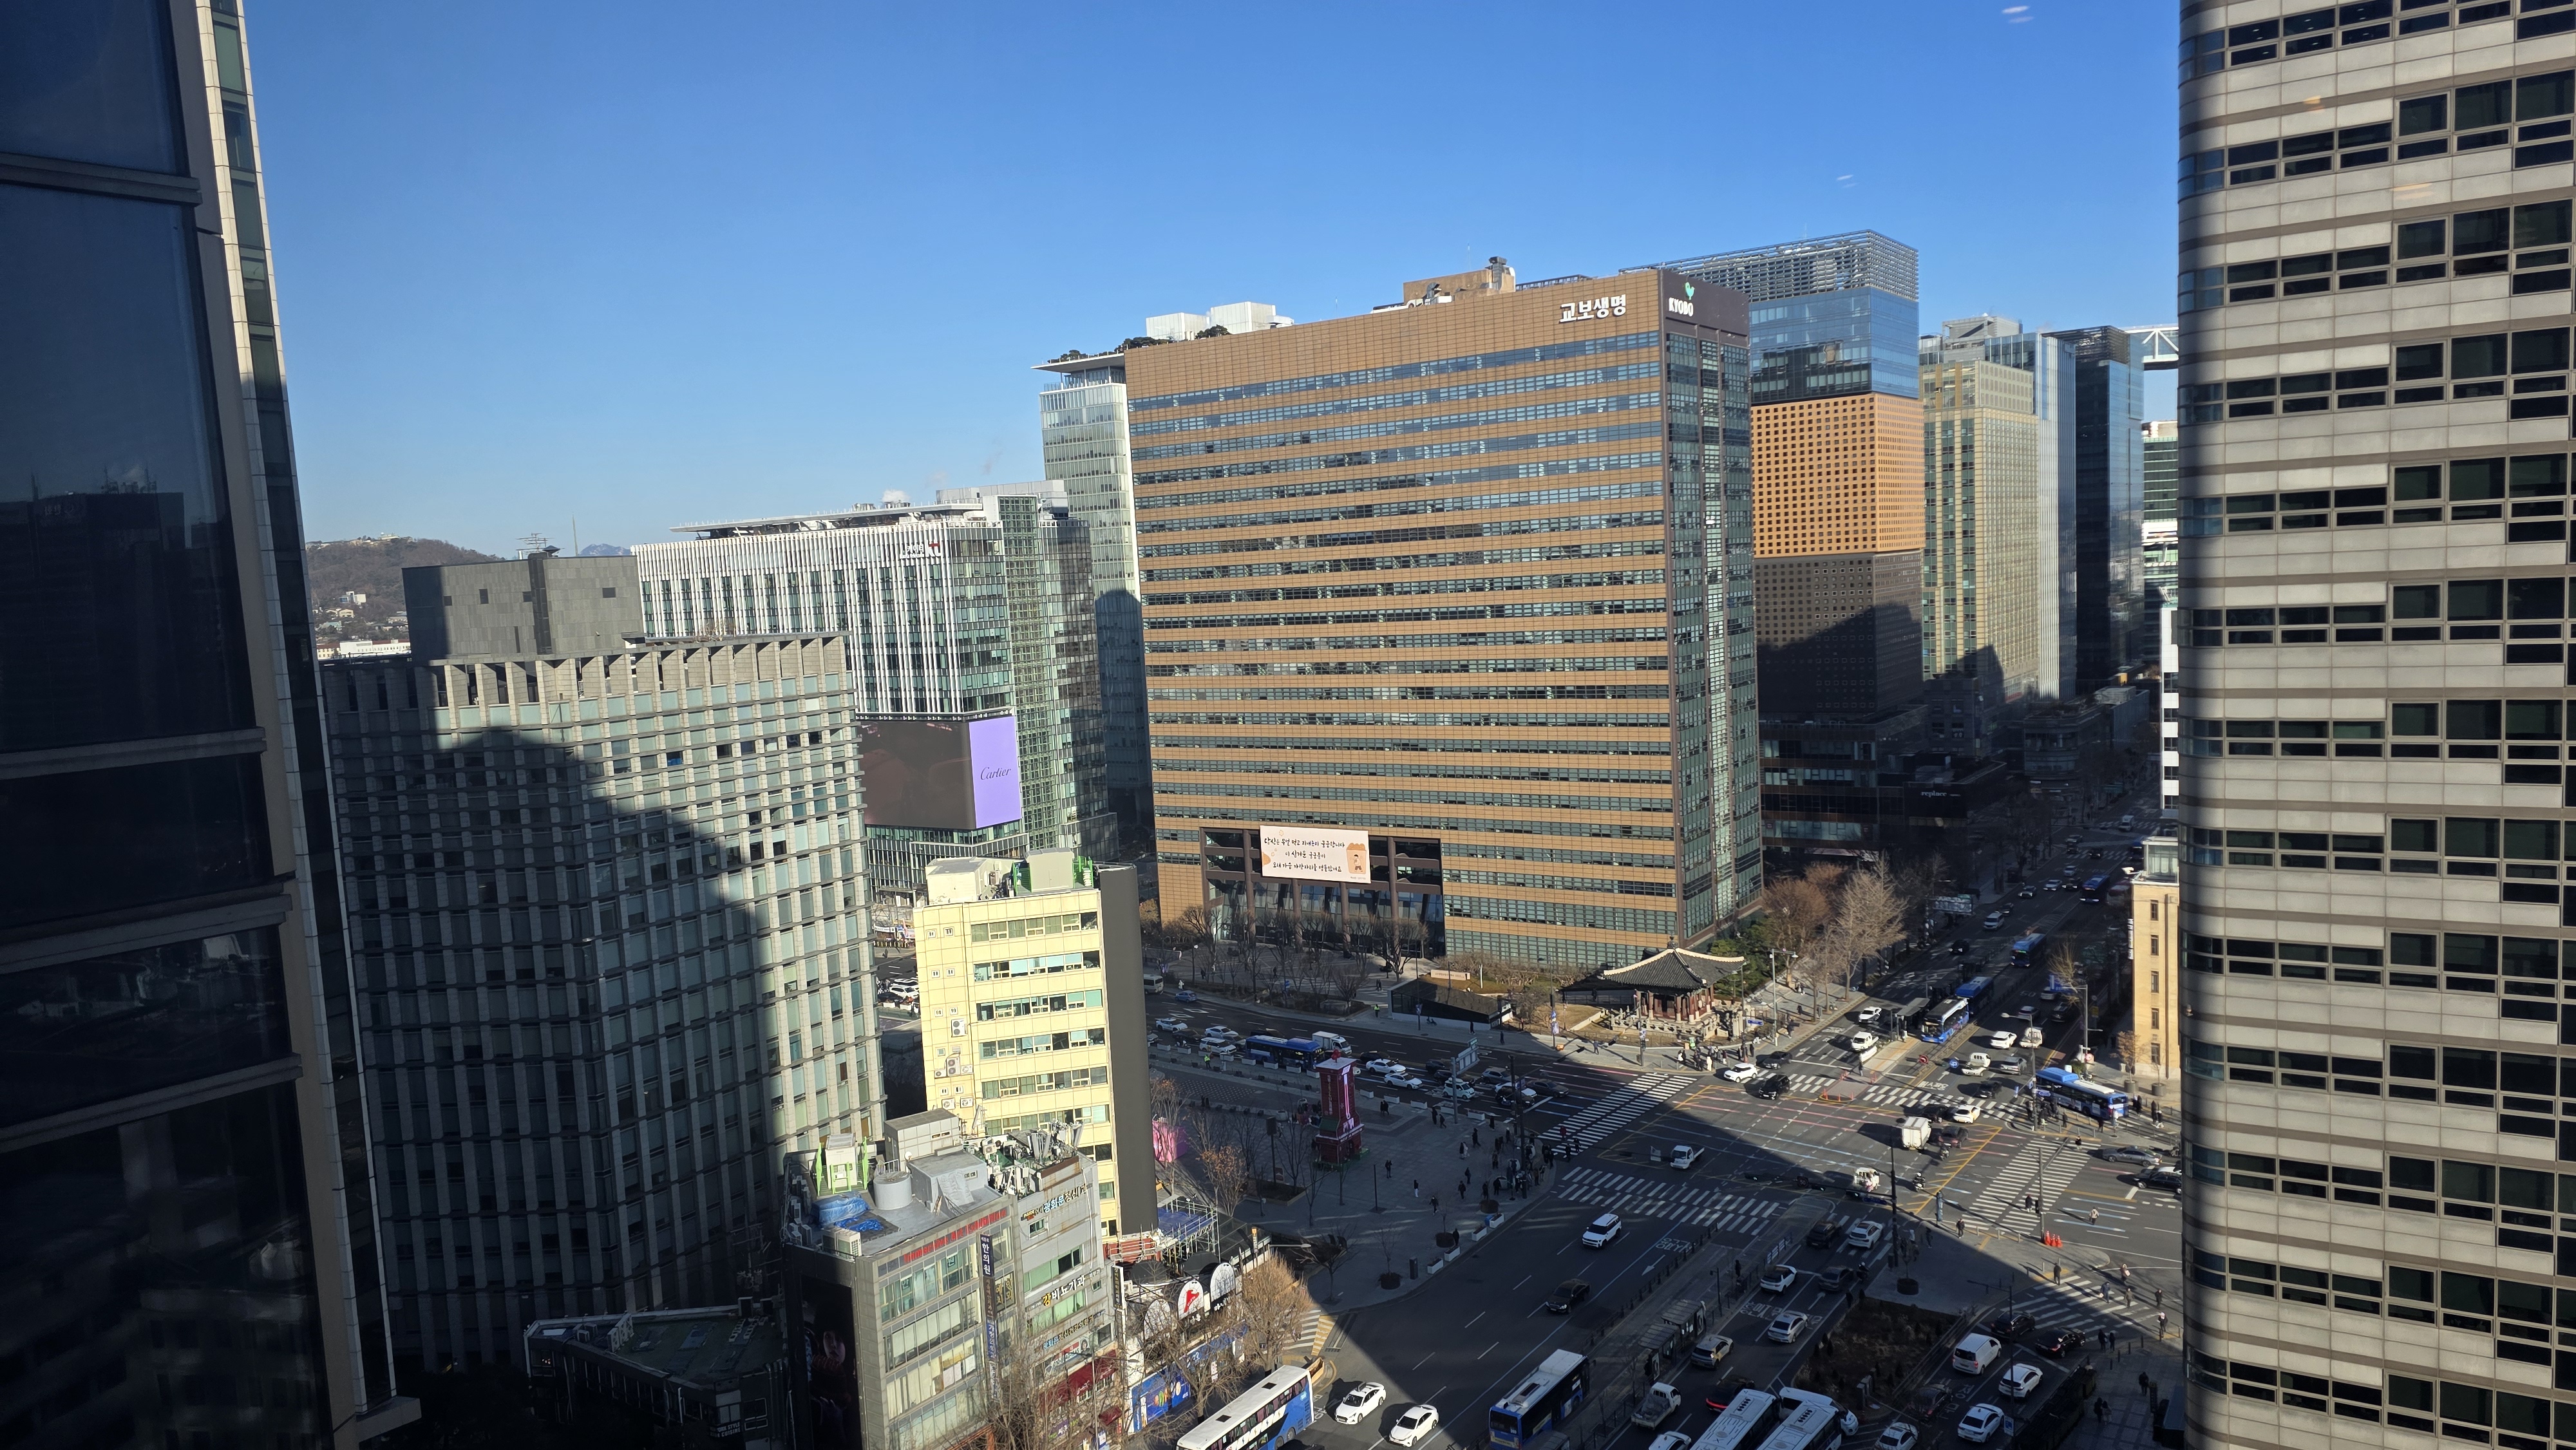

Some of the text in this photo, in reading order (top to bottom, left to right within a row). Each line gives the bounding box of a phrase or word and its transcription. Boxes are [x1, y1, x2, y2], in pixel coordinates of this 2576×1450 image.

[1559, 294, 1626, 323] 교보생명
[1669, 297, 1694, 317] KYOBO
[980, 766, 1012, 780] Cartier
[1291, 850, 1306, 858] 싱거운
[951, 1227, 963, 1242] Art
[982, 1243, 990, 1275] 한의원
[1043, 1275, 1086, 1306] 강비뇨기과
